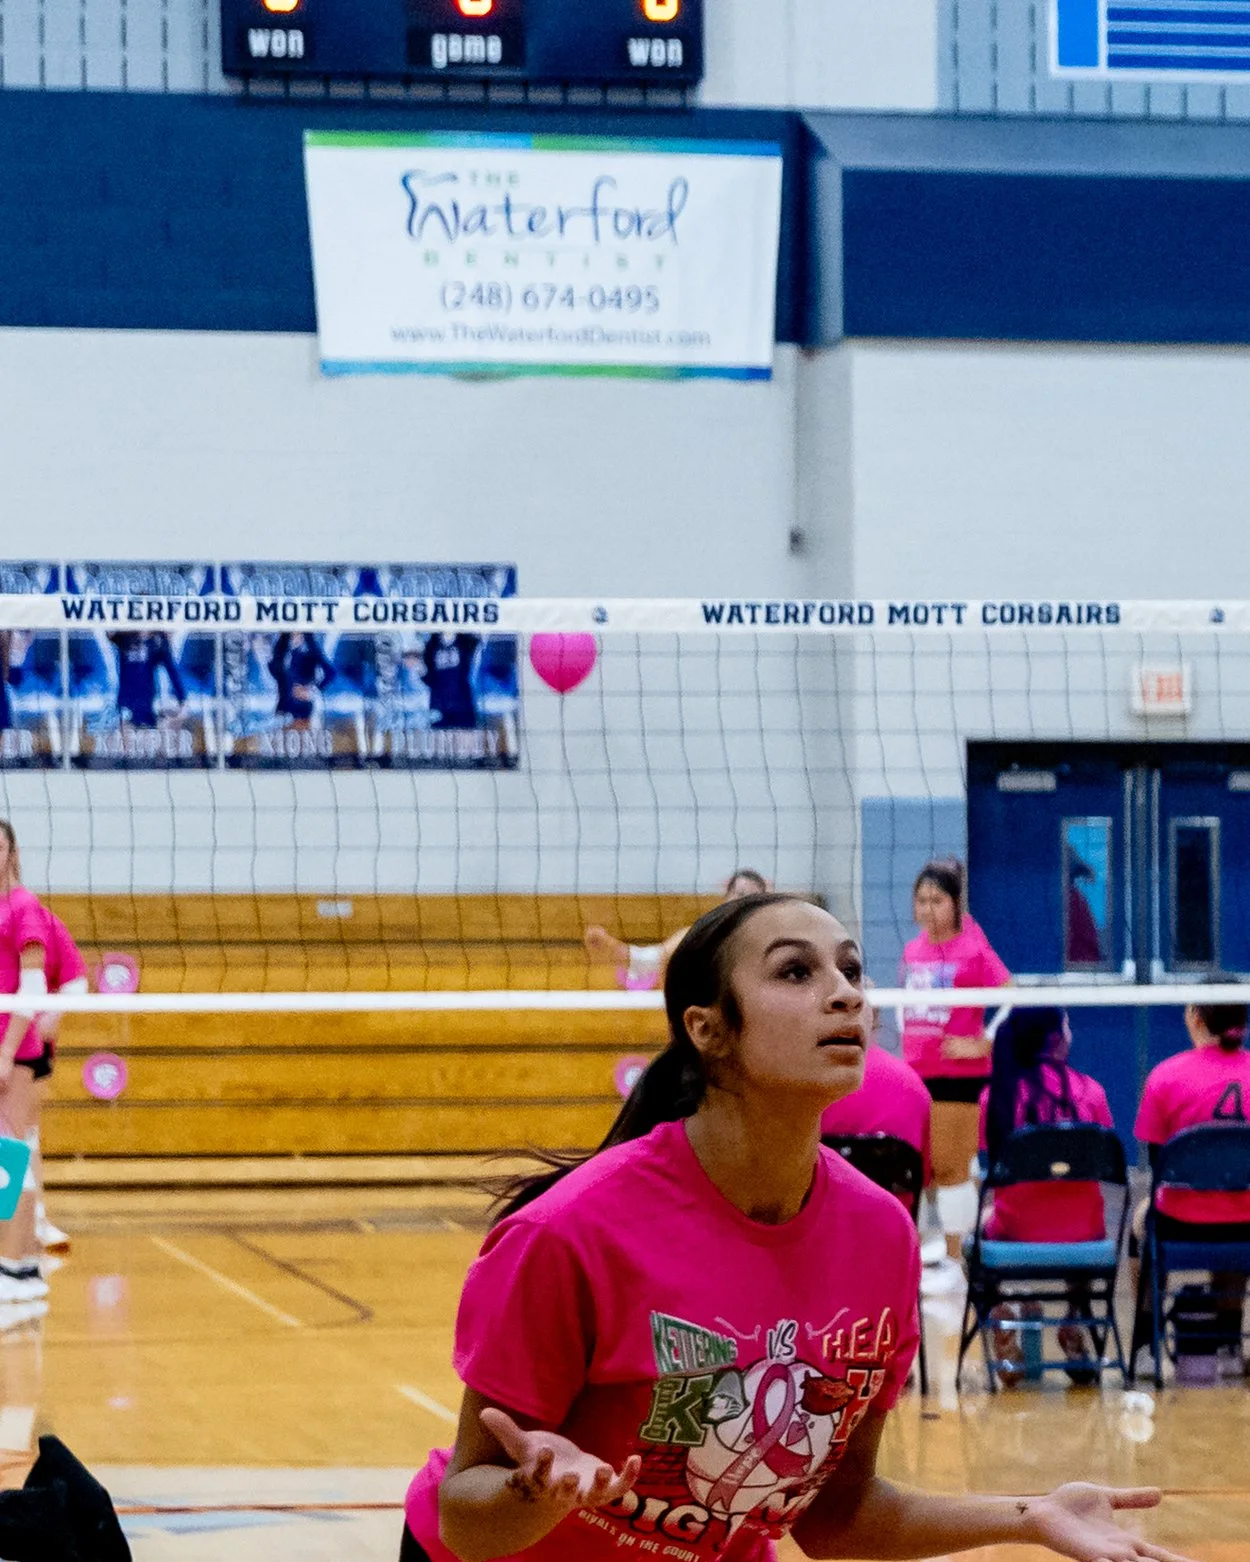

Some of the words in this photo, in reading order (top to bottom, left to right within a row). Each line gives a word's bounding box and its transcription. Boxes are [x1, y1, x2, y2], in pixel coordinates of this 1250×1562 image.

[248, 29, 304, 58] won
[431, 33, 501, 69] game
[628, 37, 683, 67] won
[401, 168, 690, 245] Waterford
[424, 249, 666, 271] DENTIST
[440, 281, 512, 312] (248)
[522, 283, 661, 315] 674-0495
[61, 599, 242, 621] WATERFORD
[256, 601, 339, 622] MOTT
[353, 602, 500, 624] CORSAIRS
[701, 603, 875, 625] WATERFORD
[887, 603, 969, 625] MOTT
[982, 602, 1121, 625] CORSAIRS
[767, 1321, 797, 1360] VS
[617, 1532, 636, 1547] ON
[639, 1538, 660, 1554] THE
